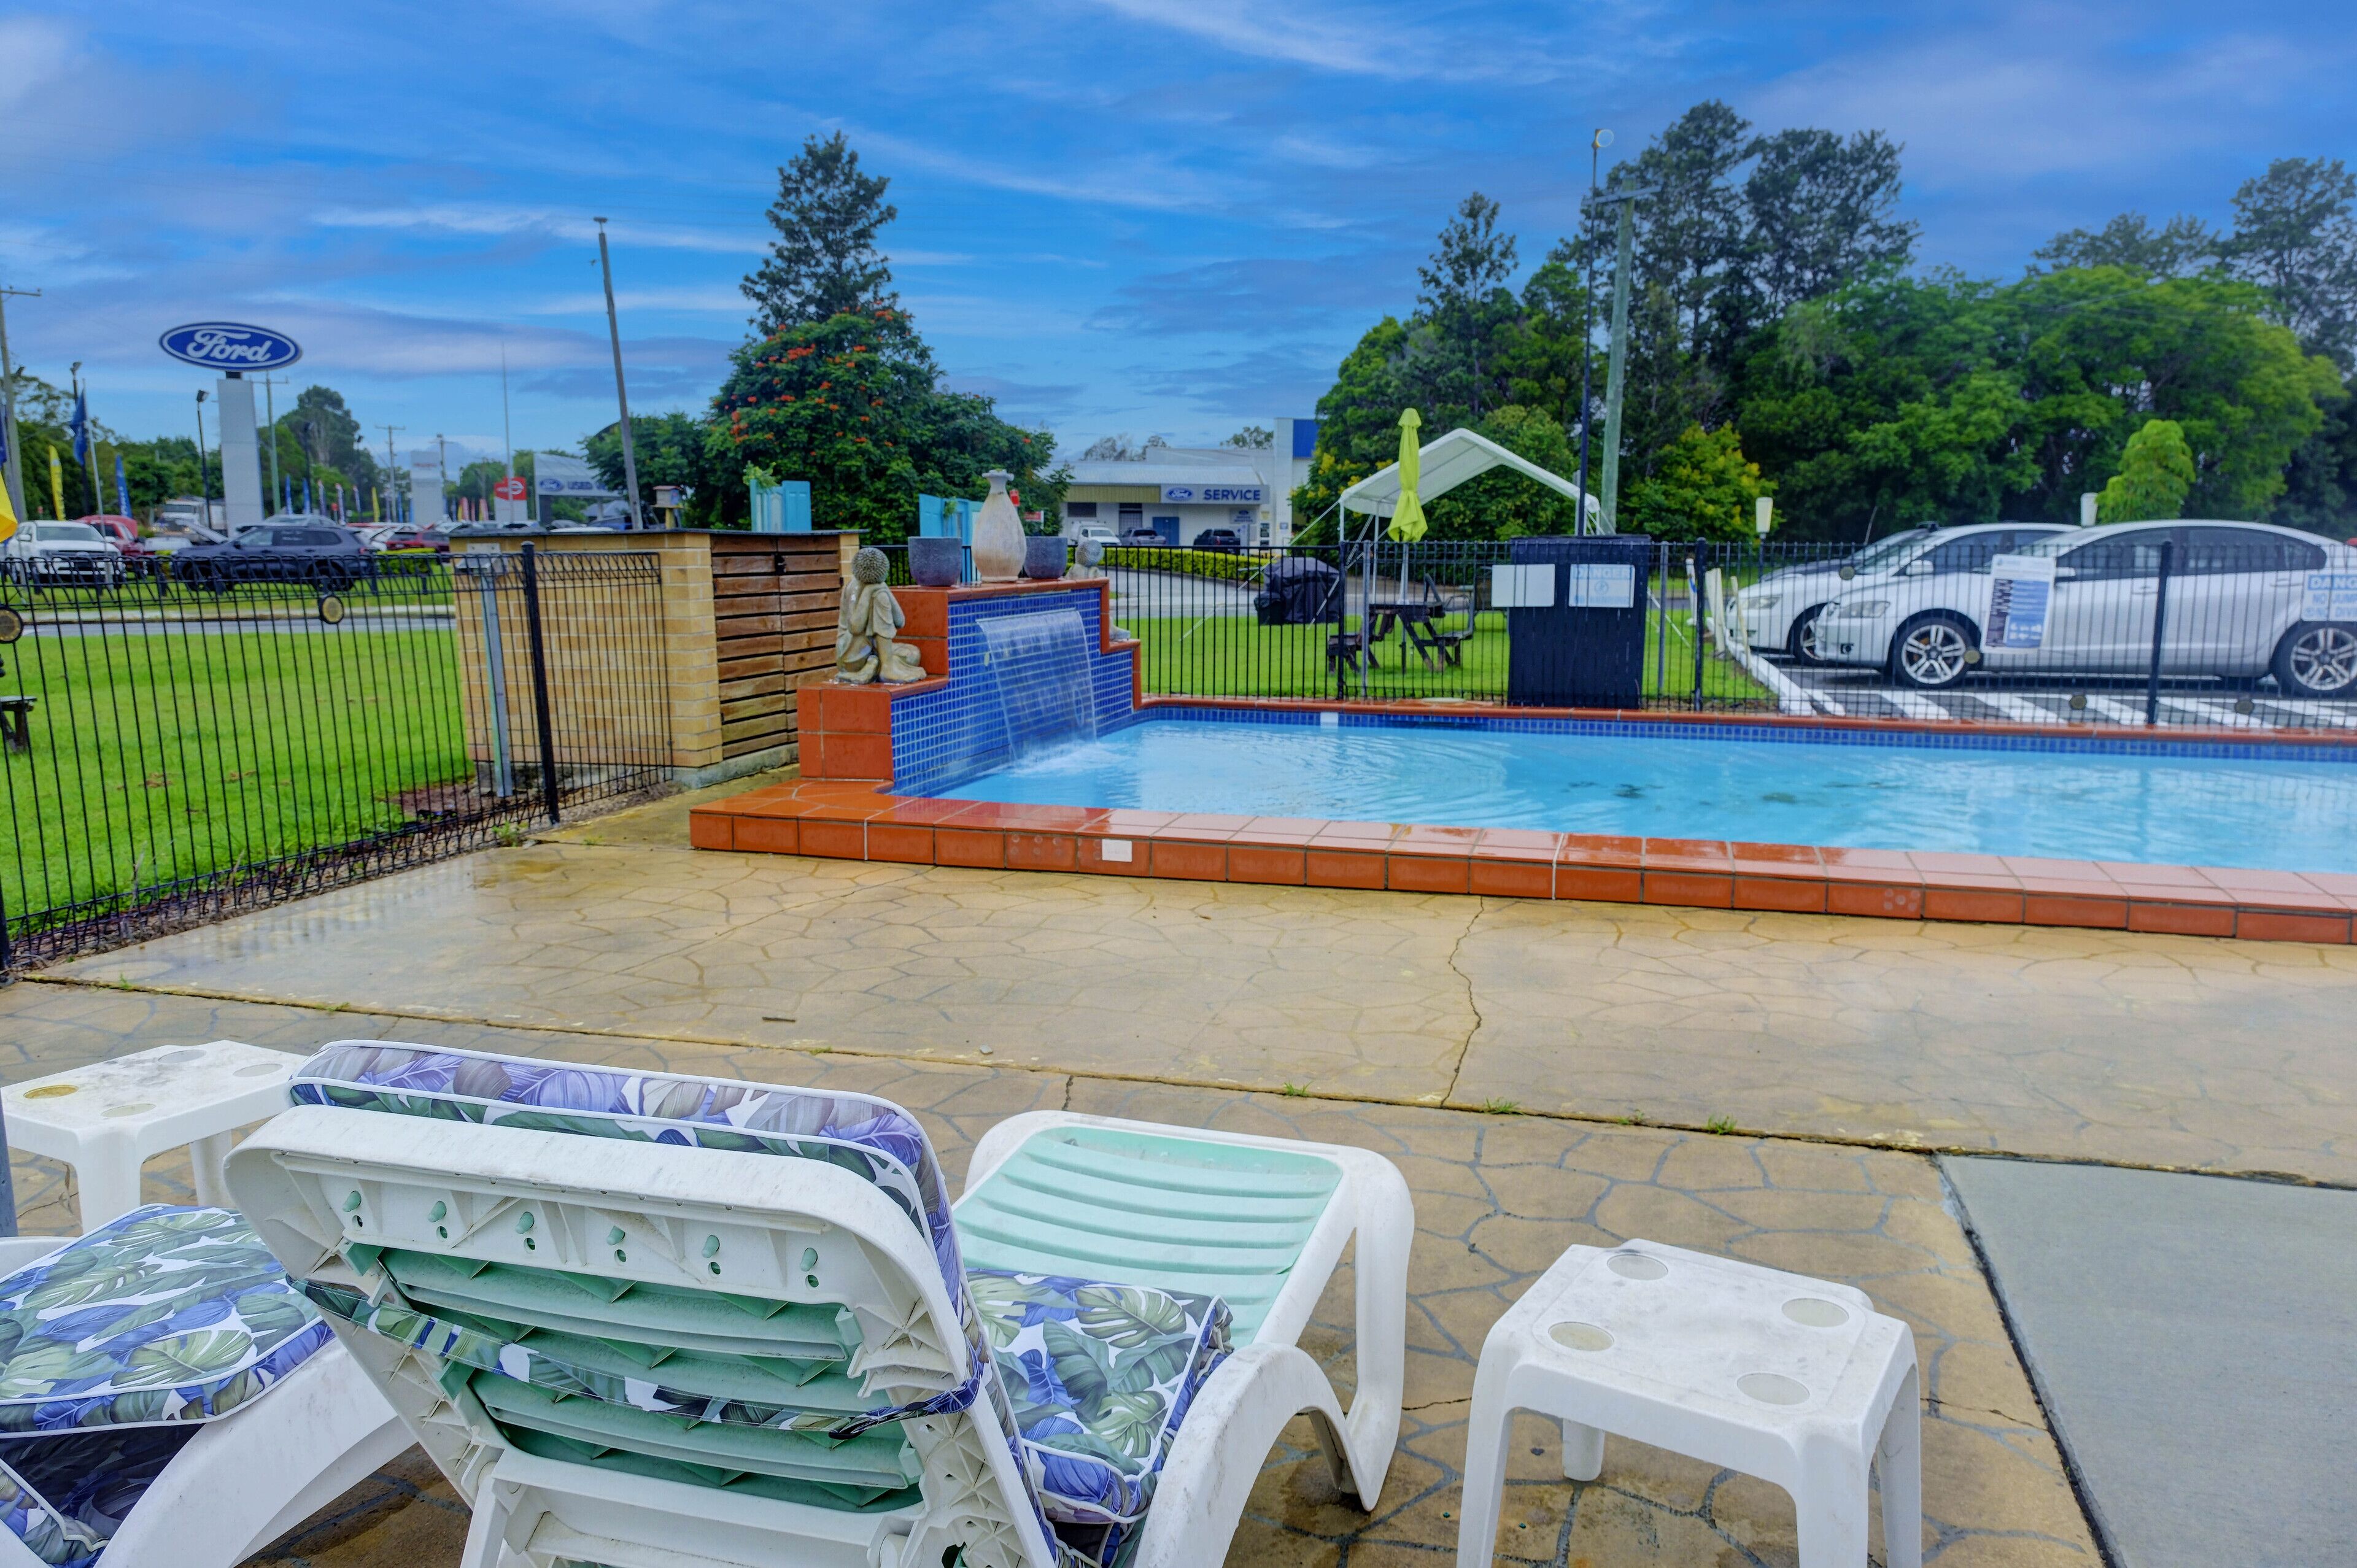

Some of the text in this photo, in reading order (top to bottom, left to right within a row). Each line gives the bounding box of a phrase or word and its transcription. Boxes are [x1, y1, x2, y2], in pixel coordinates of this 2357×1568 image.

[186, 329, 273, 362] Ford
[1204, 489, 1260, 500] SERVICE
[1573, 568, 1631, 578] DANGER
